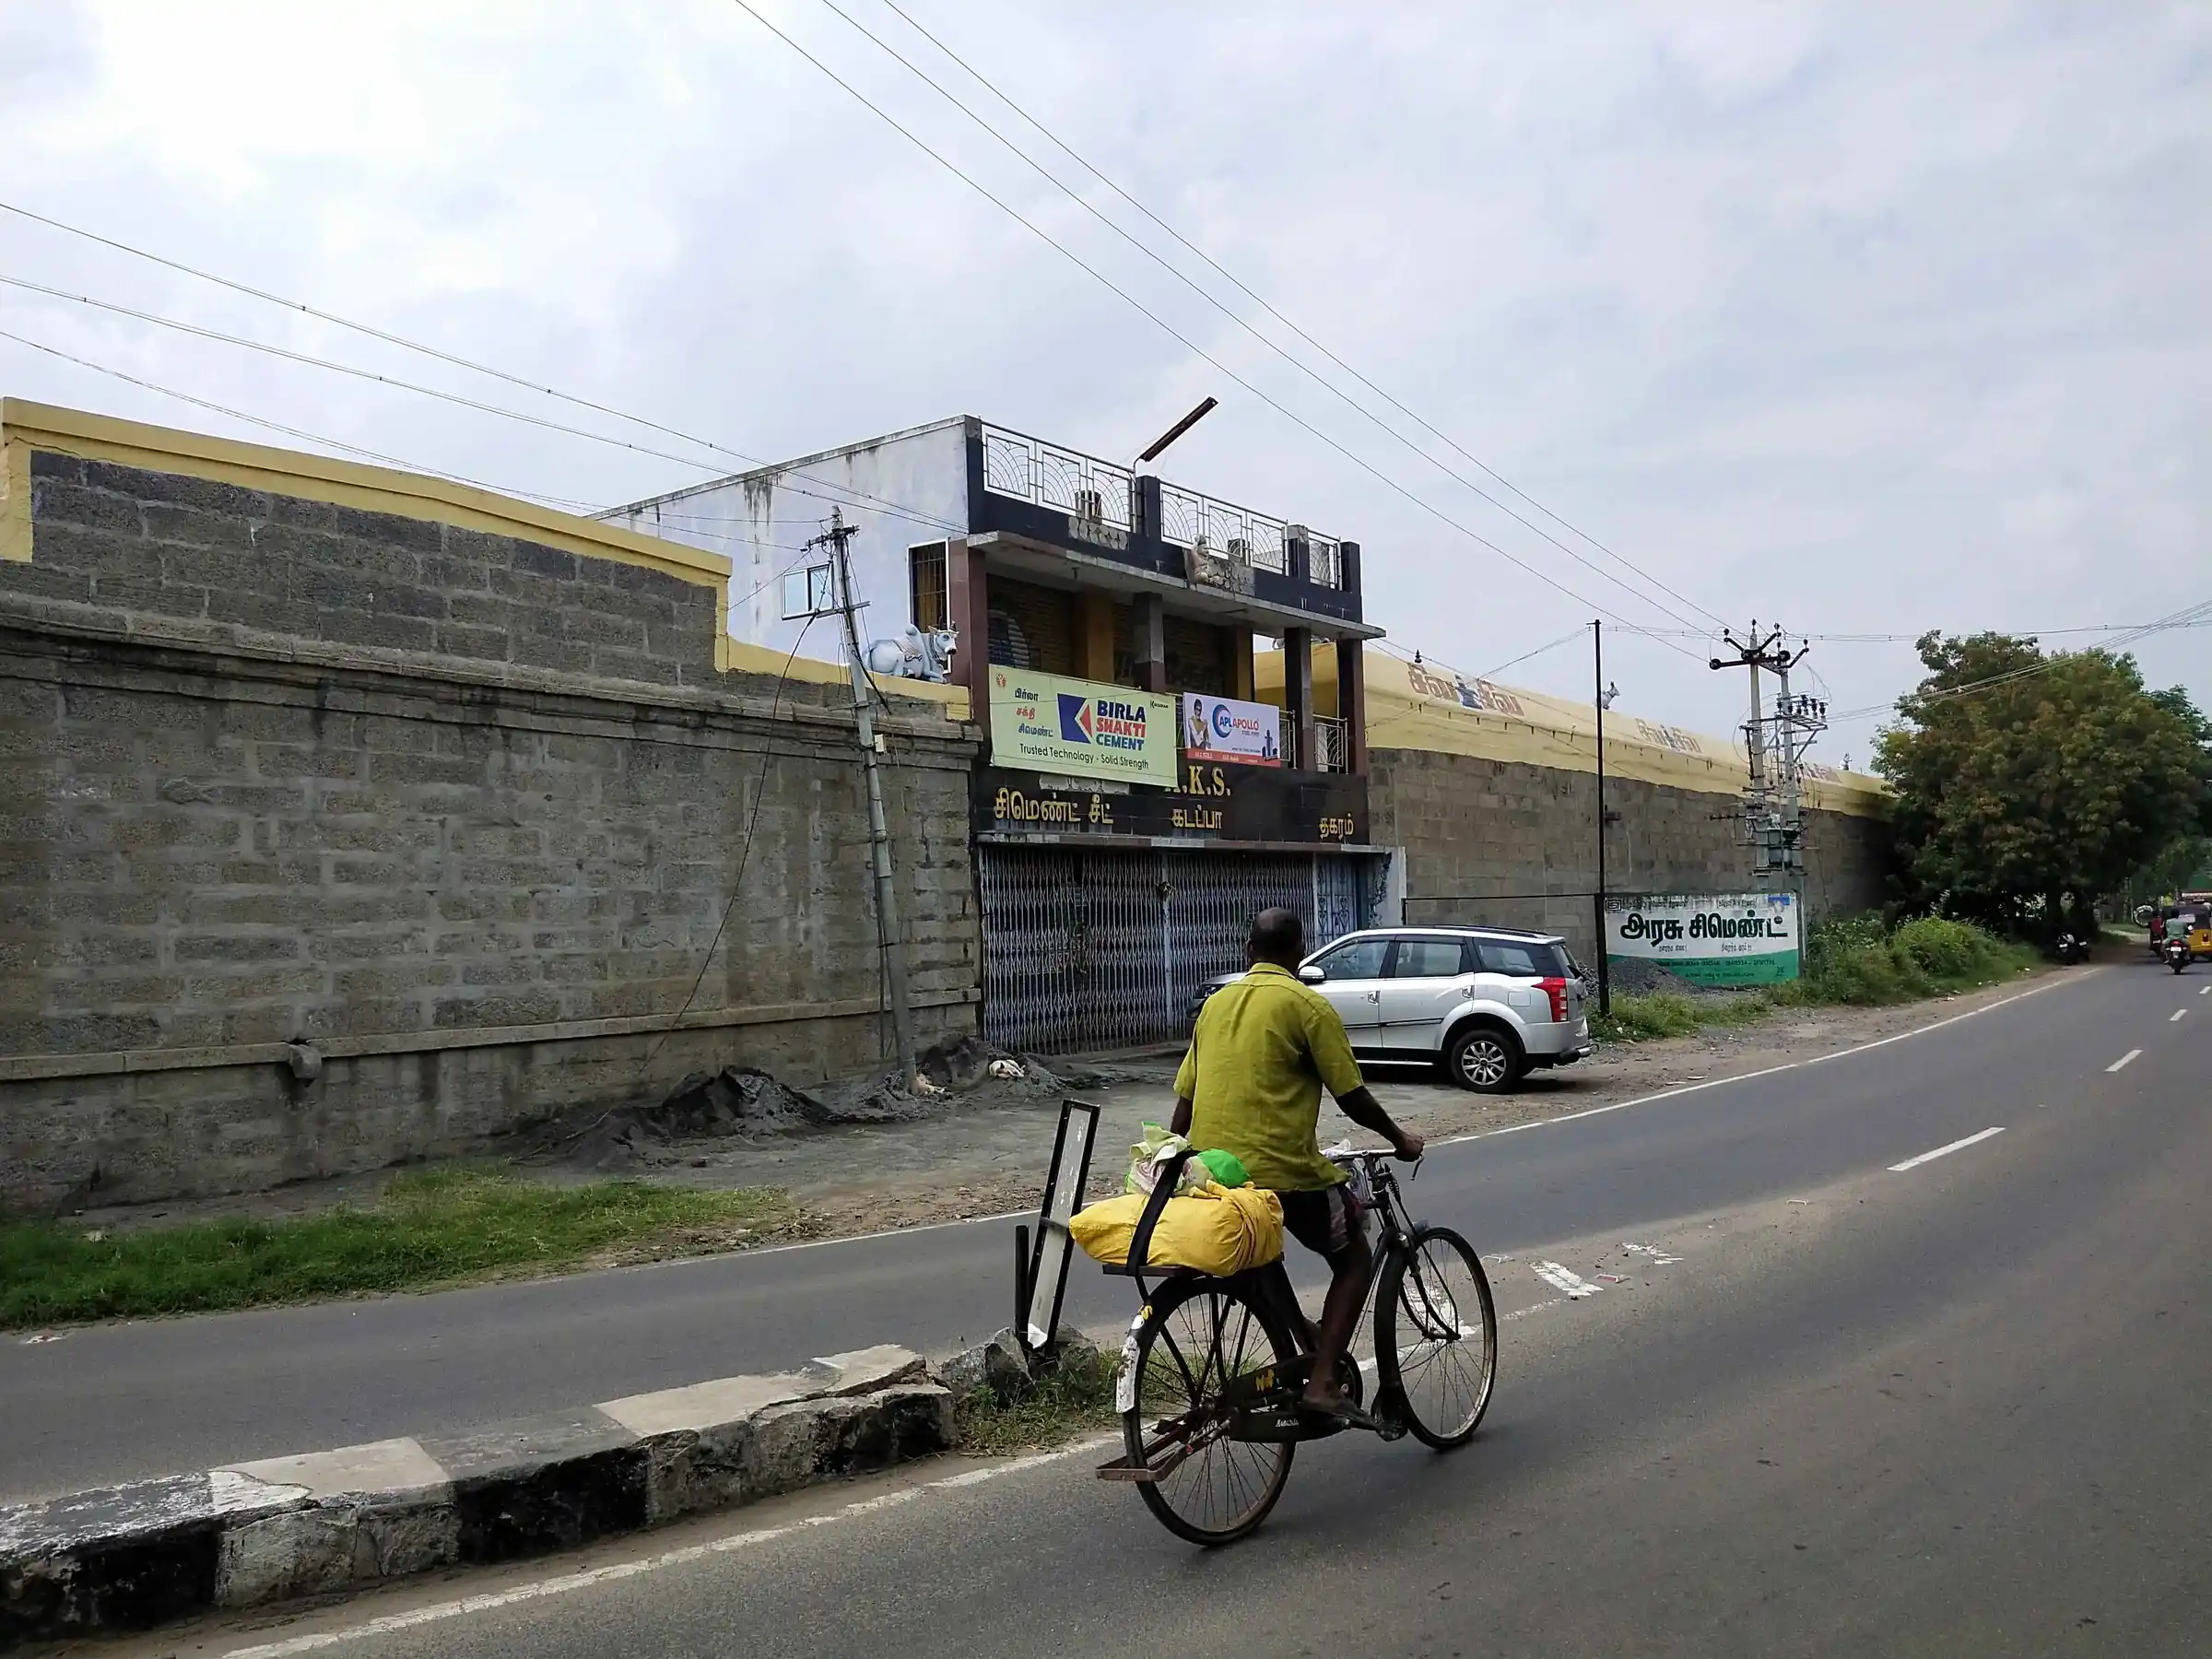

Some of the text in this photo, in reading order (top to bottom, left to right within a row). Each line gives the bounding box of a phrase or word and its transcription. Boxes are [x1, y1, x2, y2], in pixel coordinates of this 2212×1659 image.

[1014, 688, 1039, 701] பிர்லா
[1016, 706, 1035, 720] சக்தி
[1097, 700, 1146, 723] BIRLA
[1096, 717, 1146, 738] SHAKTI
[1232, 718, 1260, 731] APOLLO
[1096, 733, 1144, 751] CEMENT
[1019, 743, 1048, 756] Trusted
[1050, 747, 1094, 764] Technology
[1100, 753, 1119, 766] Solid
[1120, 756, 1149, 771] Strength
[994, 787, 1354, 841] சிமெண்ட் சீட் கடப்பா தகரம்
[1620, 909, 1788, 947] அரசு சிமெண்ட்
